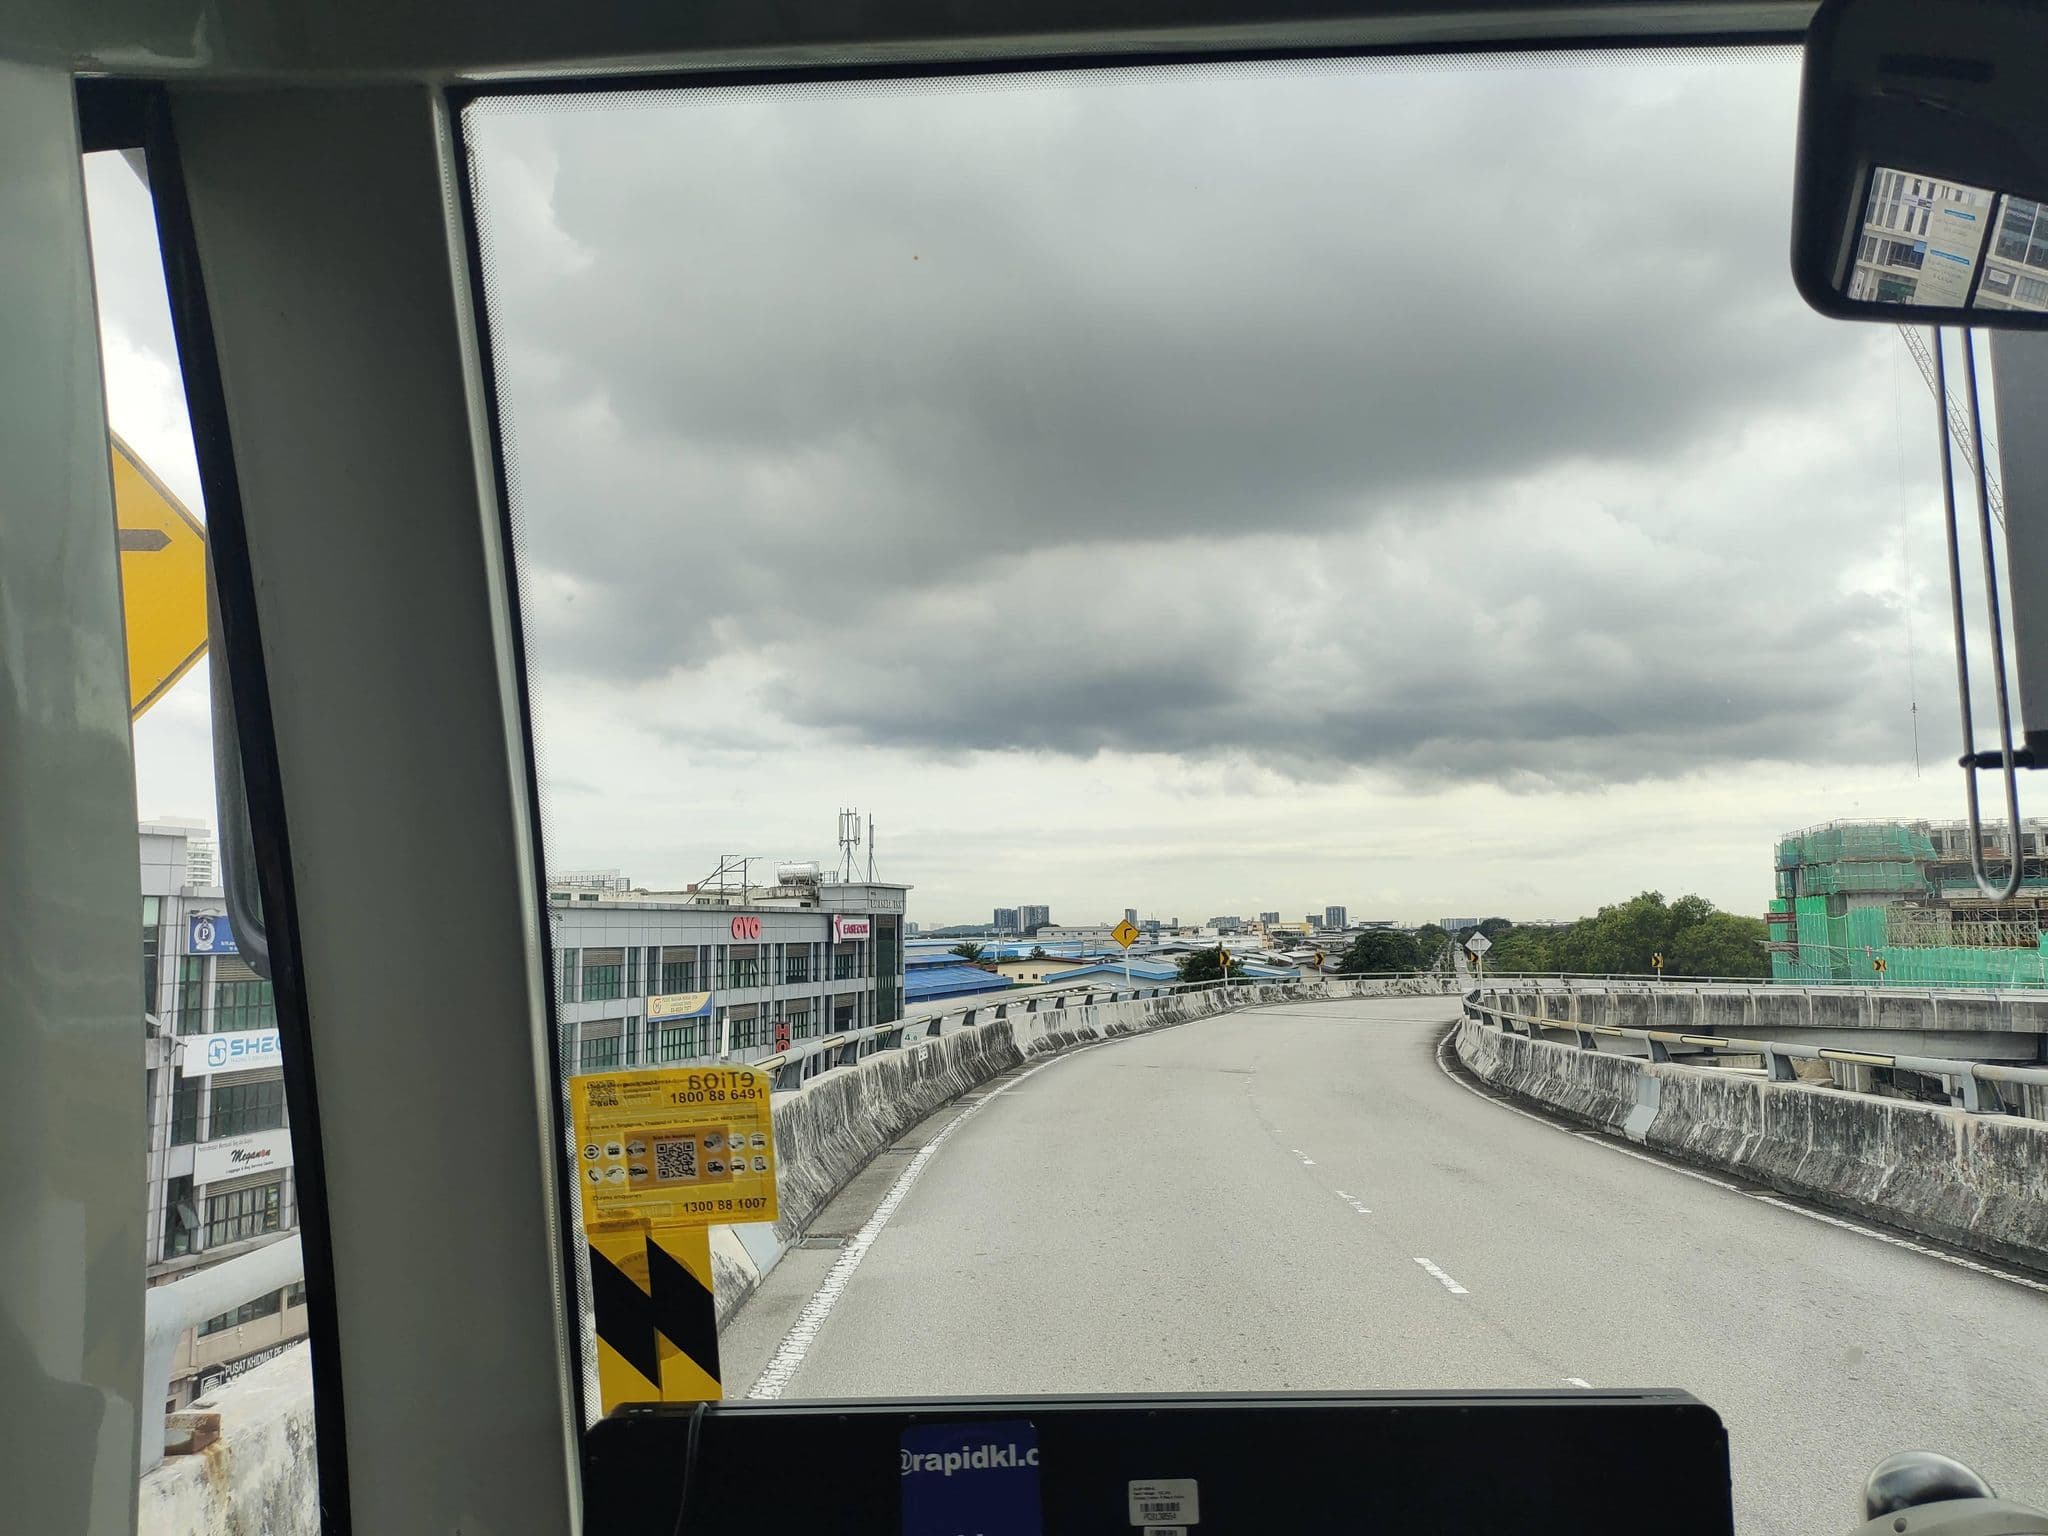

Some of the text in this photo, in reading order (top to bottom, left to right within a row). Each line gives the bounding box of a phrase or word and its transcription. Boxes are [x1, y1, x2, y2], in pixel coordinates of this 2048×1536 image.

[202, 928, 209, 939] P
[731, 916, 761, 940] OYO
[670, 1087, 764, 1104] 1800 88 6491
[683, 1197, 768, 1213] 1300 88 1007
[225, 1357, 247, 1377] PUSAT
[246, 1348, 274, 1371] KHIDMAT
